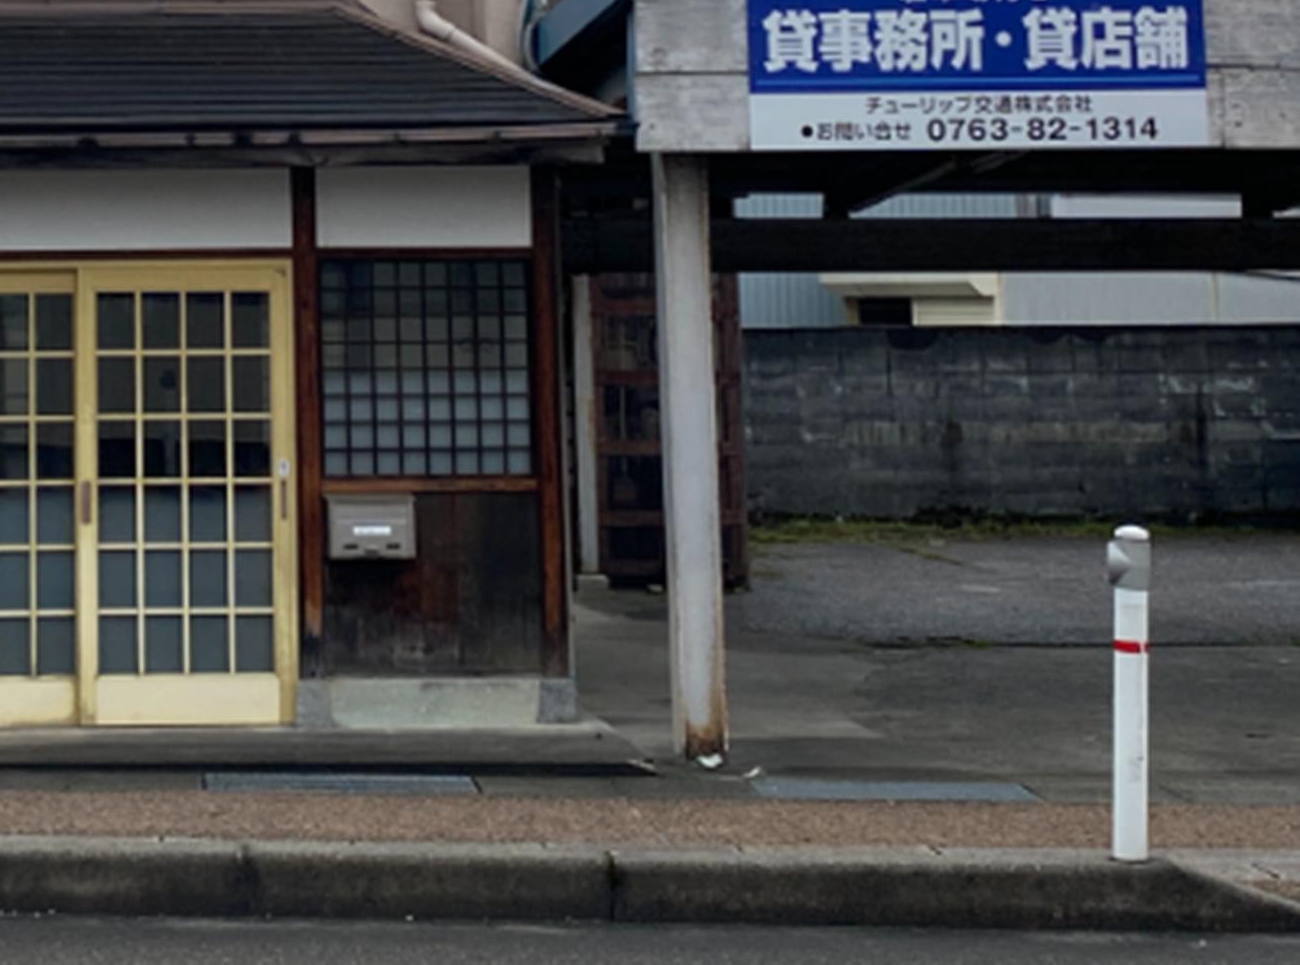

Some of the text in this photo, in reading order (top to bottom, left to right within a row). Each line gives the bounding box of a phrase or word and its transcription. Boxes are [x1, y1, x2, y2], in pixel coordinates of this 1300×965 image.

[762, 7, 1188, 72] 貸事務所・貸店舗
[866, 95, 1093, 115] チューリップ交通株式会社
[926, 117, 1159, 142] 0763-82-1314
